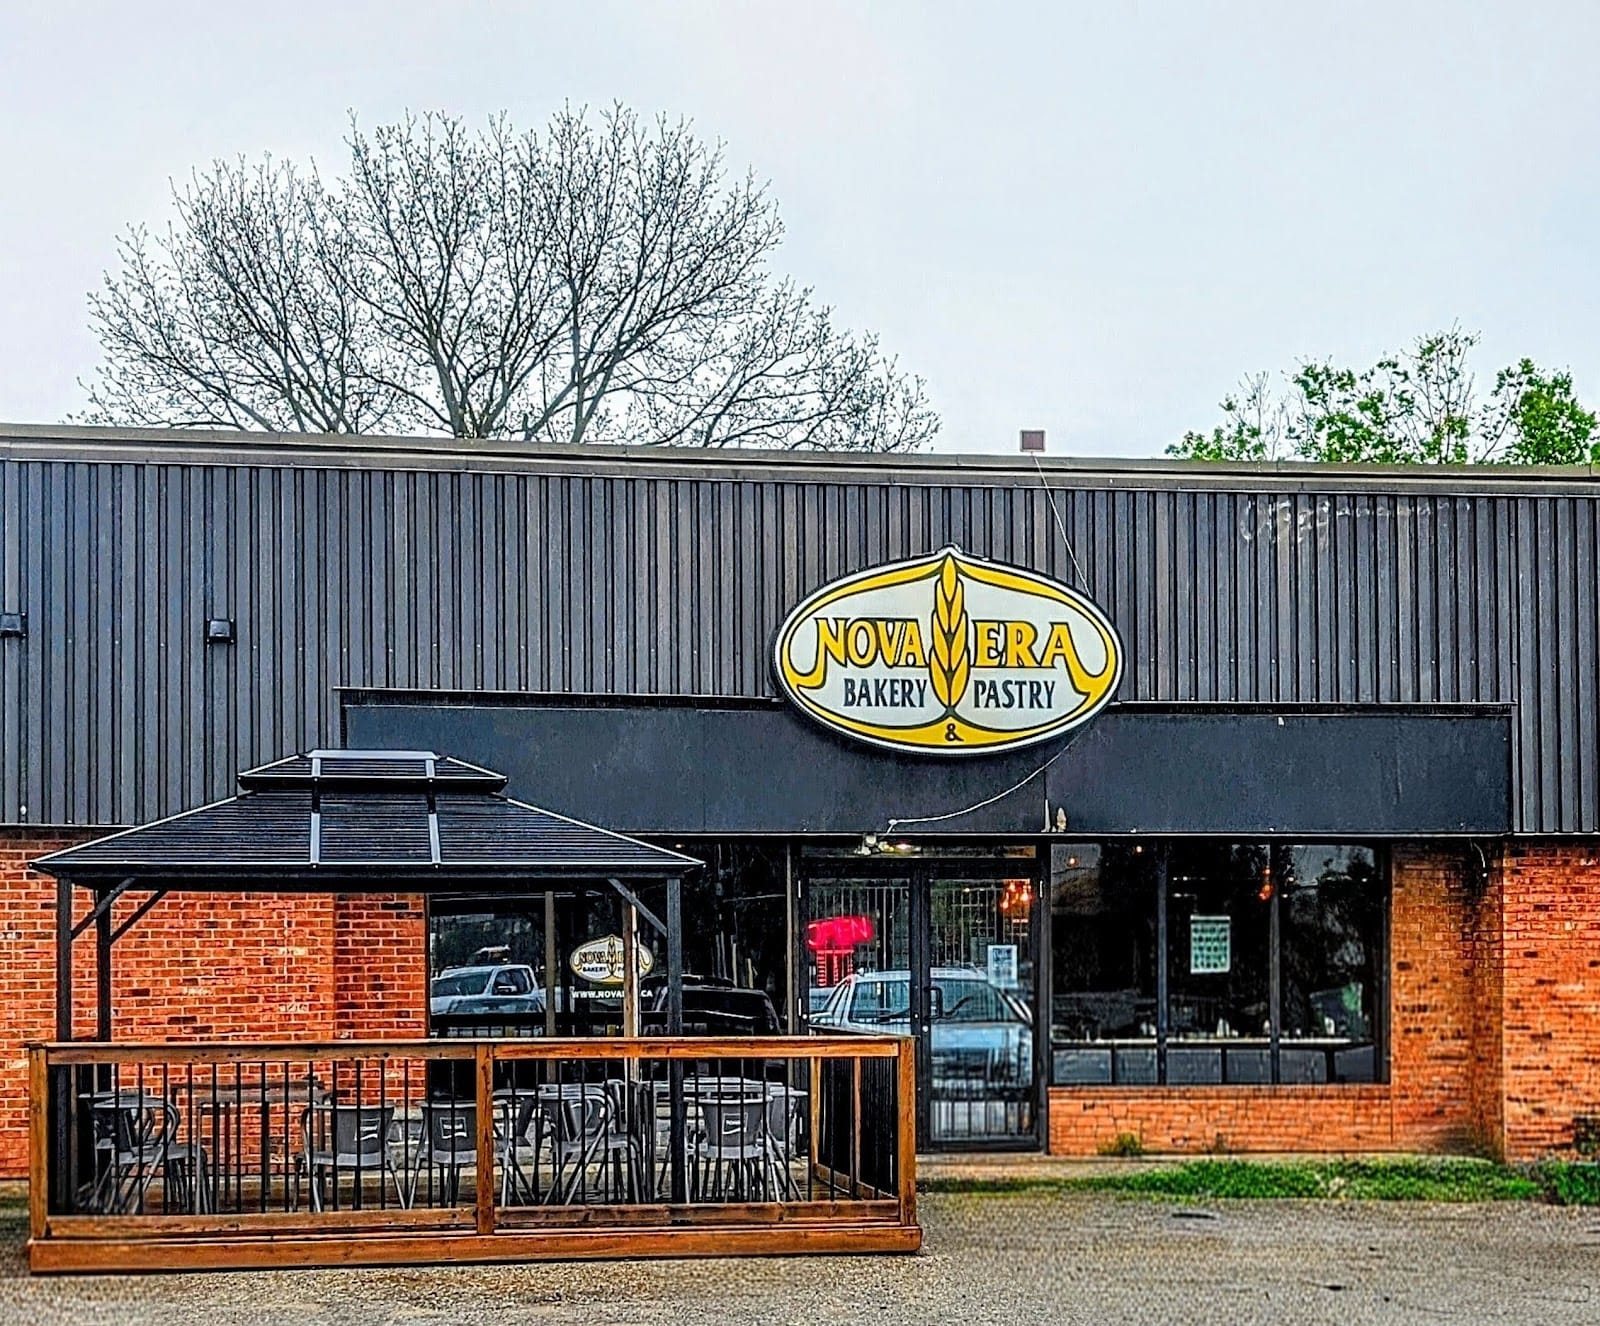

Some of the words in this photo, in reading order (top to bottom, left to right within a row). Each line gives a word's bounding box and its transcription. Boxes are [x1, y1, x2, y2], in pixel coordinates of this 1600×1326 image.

[810, 617, 929, 671] NOVA
[971, 619, 1078, 671] ERA
[843, 678, 928, 709] BAKERY
[973, 679, 1057, 710] PASTRY
[944, 722, 965, 742] &
